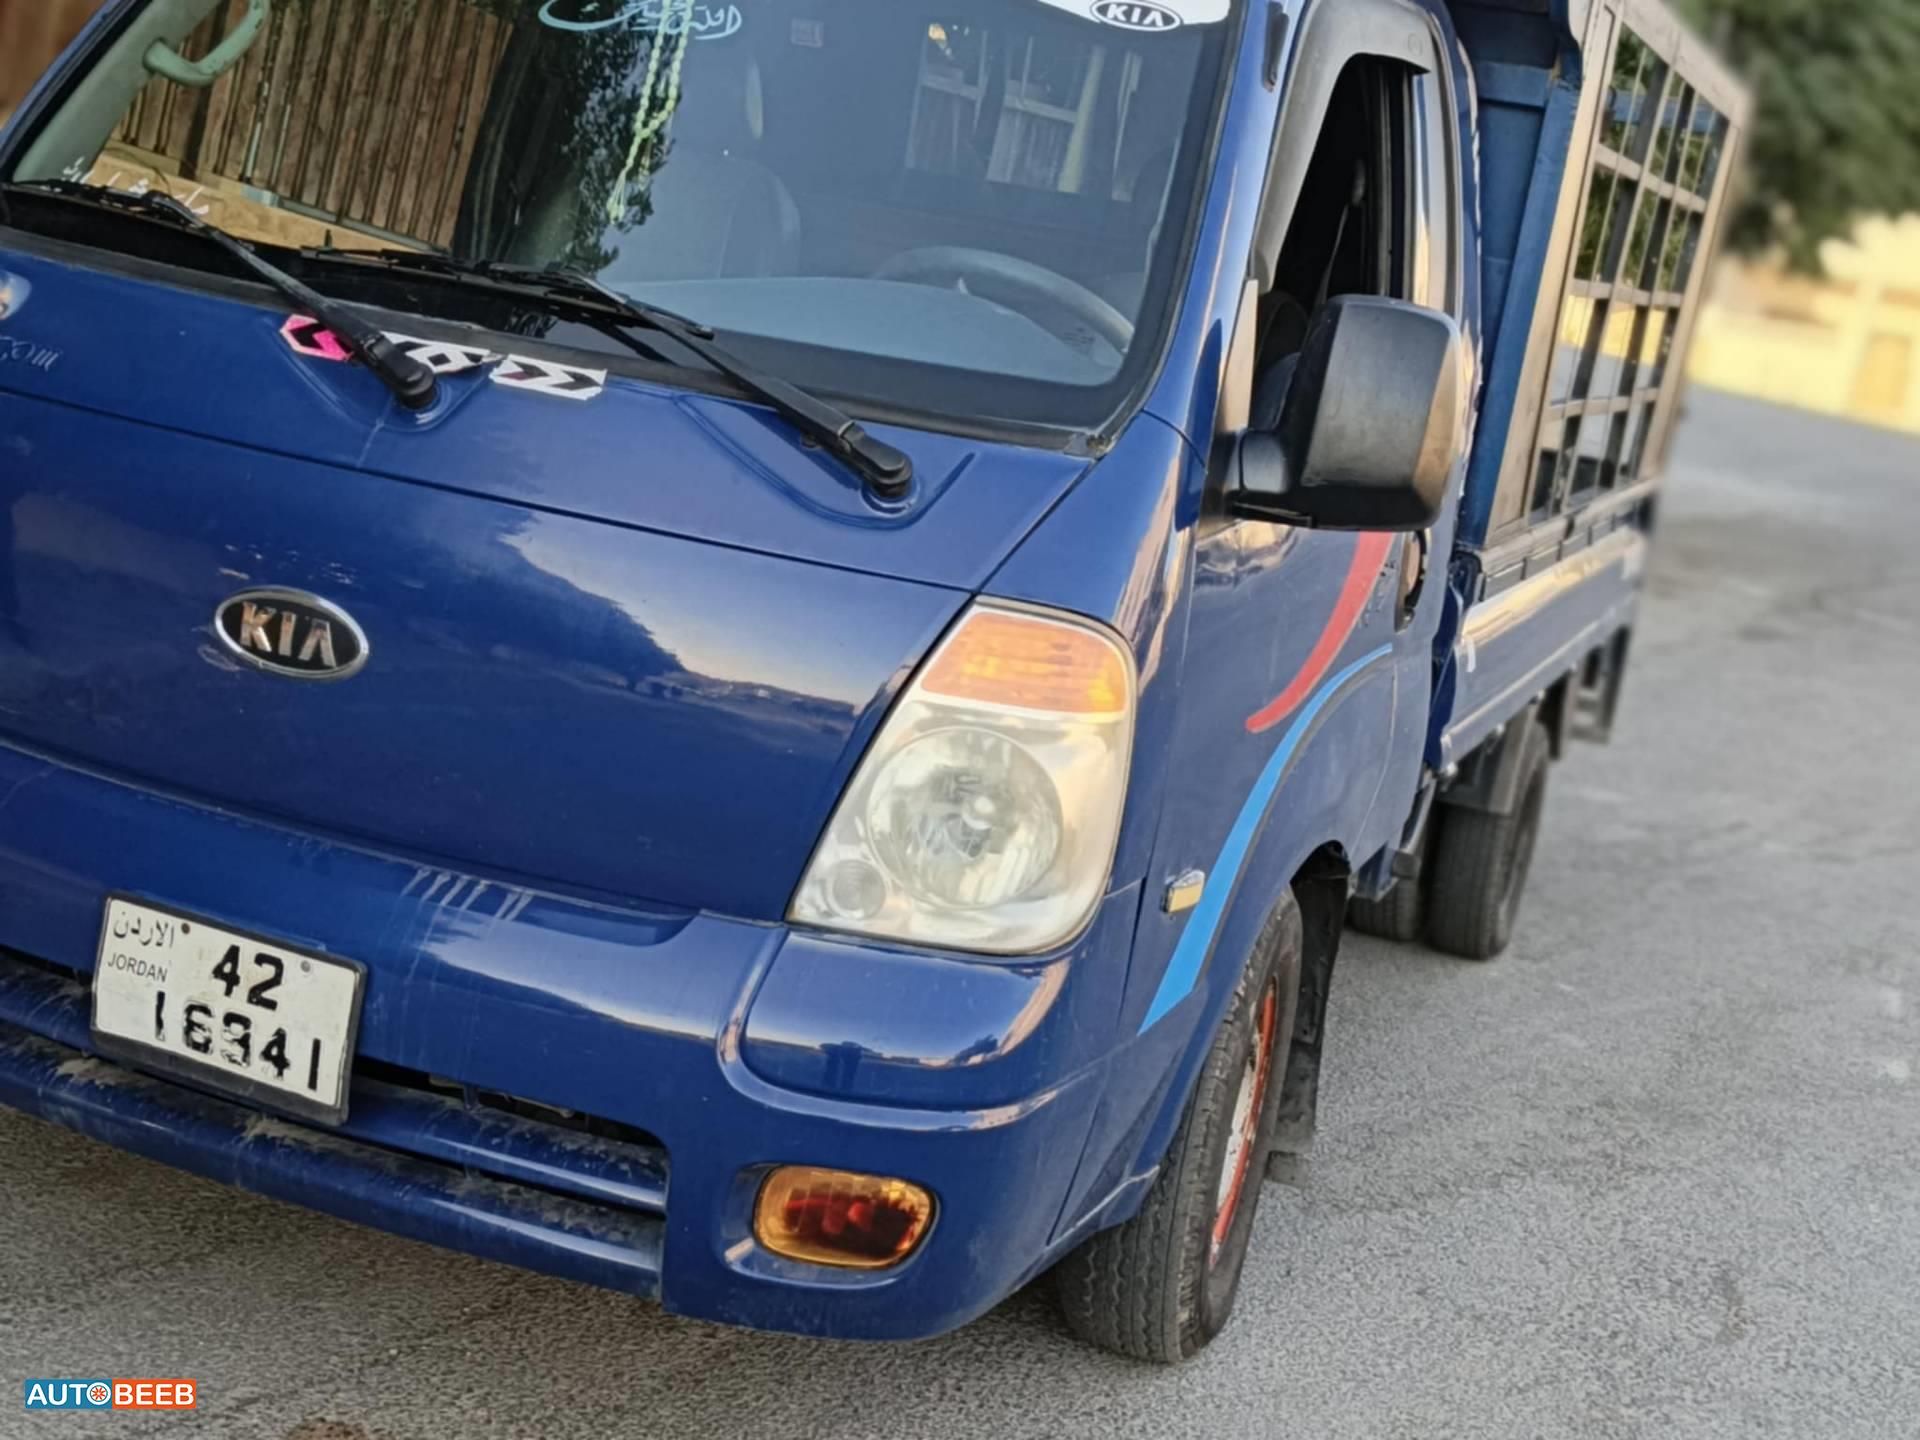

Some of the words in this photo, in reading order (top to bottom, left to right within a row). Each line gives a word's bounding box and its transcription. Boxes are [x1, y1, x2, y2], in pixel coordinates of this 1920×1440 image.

[1106, 3, 1164, 27] KIA
[239, 601, 337, 668] KIA
[107, 952, 168, 983] JORDAN
[212, 944, 285, 1011] 42
